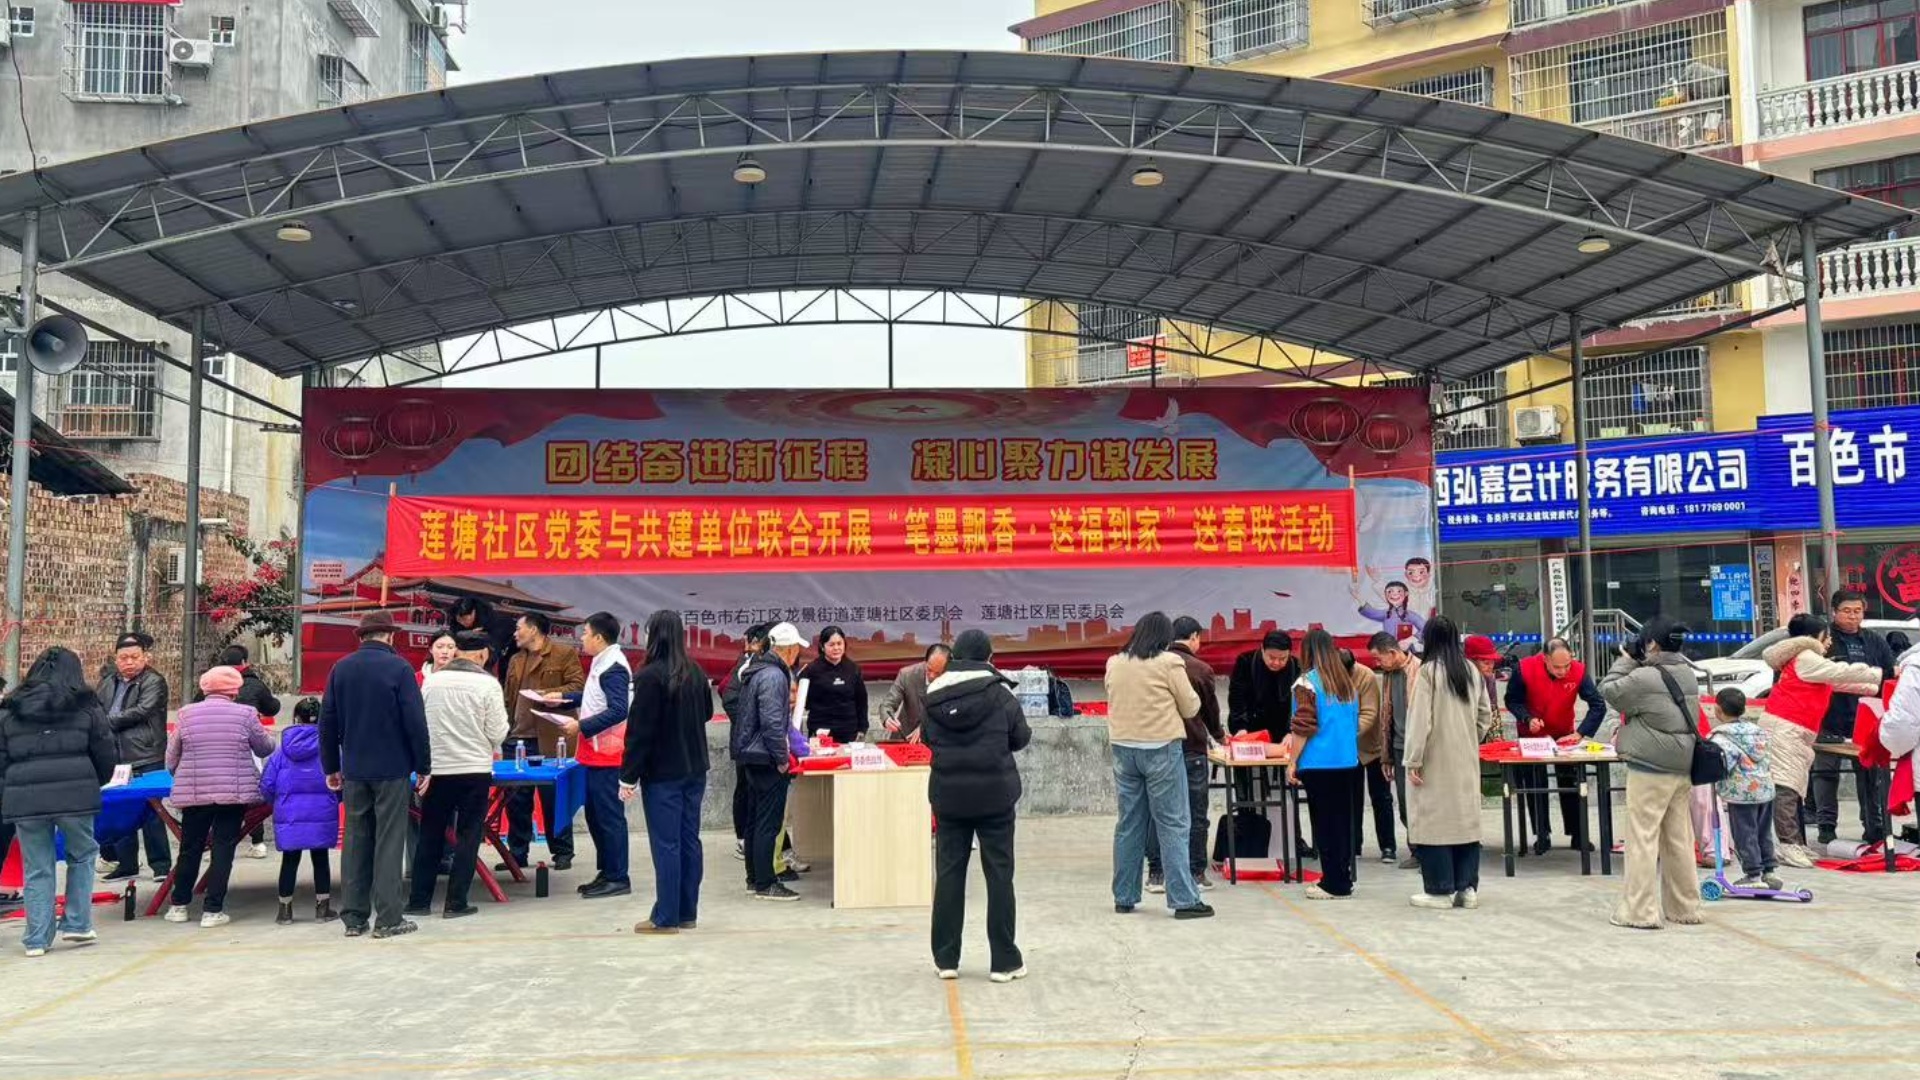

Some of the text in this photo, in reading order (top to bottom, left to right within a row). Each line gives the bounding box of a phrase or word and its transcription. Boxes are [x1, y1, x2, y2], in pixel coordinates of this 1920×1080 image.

[545, 438, 1218, 484] 团结奋进新征程 凝心聚力谋发展
[1436, 449, 1748, 507] 西弘嘉会计服务有限公司
[1781, 424, 1908, 487] 百色市
[651, 603, 1125, 625] 百色市右江区龙景街道莲塘社区委员会 莲塘社区居民委员会
